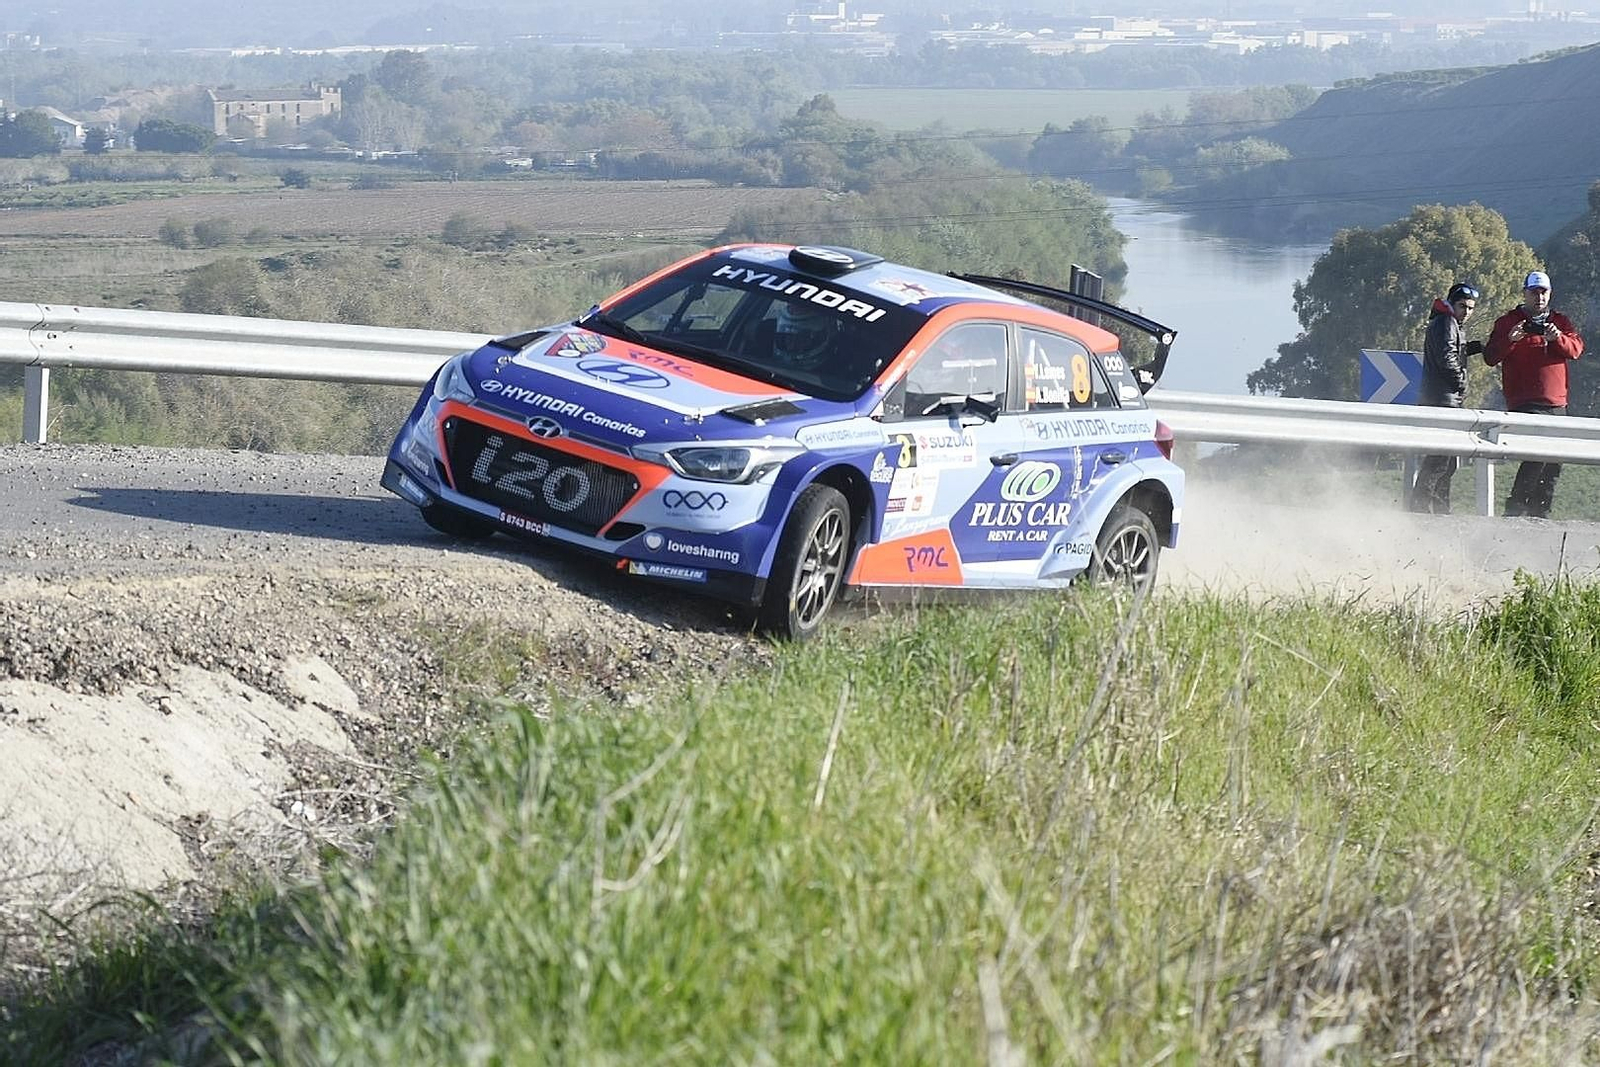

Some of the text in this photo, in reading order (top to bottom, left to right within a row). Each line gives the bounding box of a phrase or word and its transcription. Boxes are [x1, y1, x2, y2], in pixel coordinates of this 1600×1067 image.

[712, 265, 887, 322] HYUNDAI
[1071, 354, 1091, 404] 8
[501, 385, 647, 438] HYUNDAI Canarias
[1051, 419, 1151, 439] HYUNDAI Canarias
[929, 436, 973, 448] SUZUKI
[506, 514, 525, 528] 8743
[525, 520, 542, 534] BCC
[968, 502, 1025, 526] PLUS
[1027, 502, 1072, 526] CAR
[987, 530, 1048, 541] RENT A CAR
[668, 539, 740, 564] lovesharing
[1065, 543, 1093, 554] PAGID
[649, 564, 705, 578] MICHELIN
